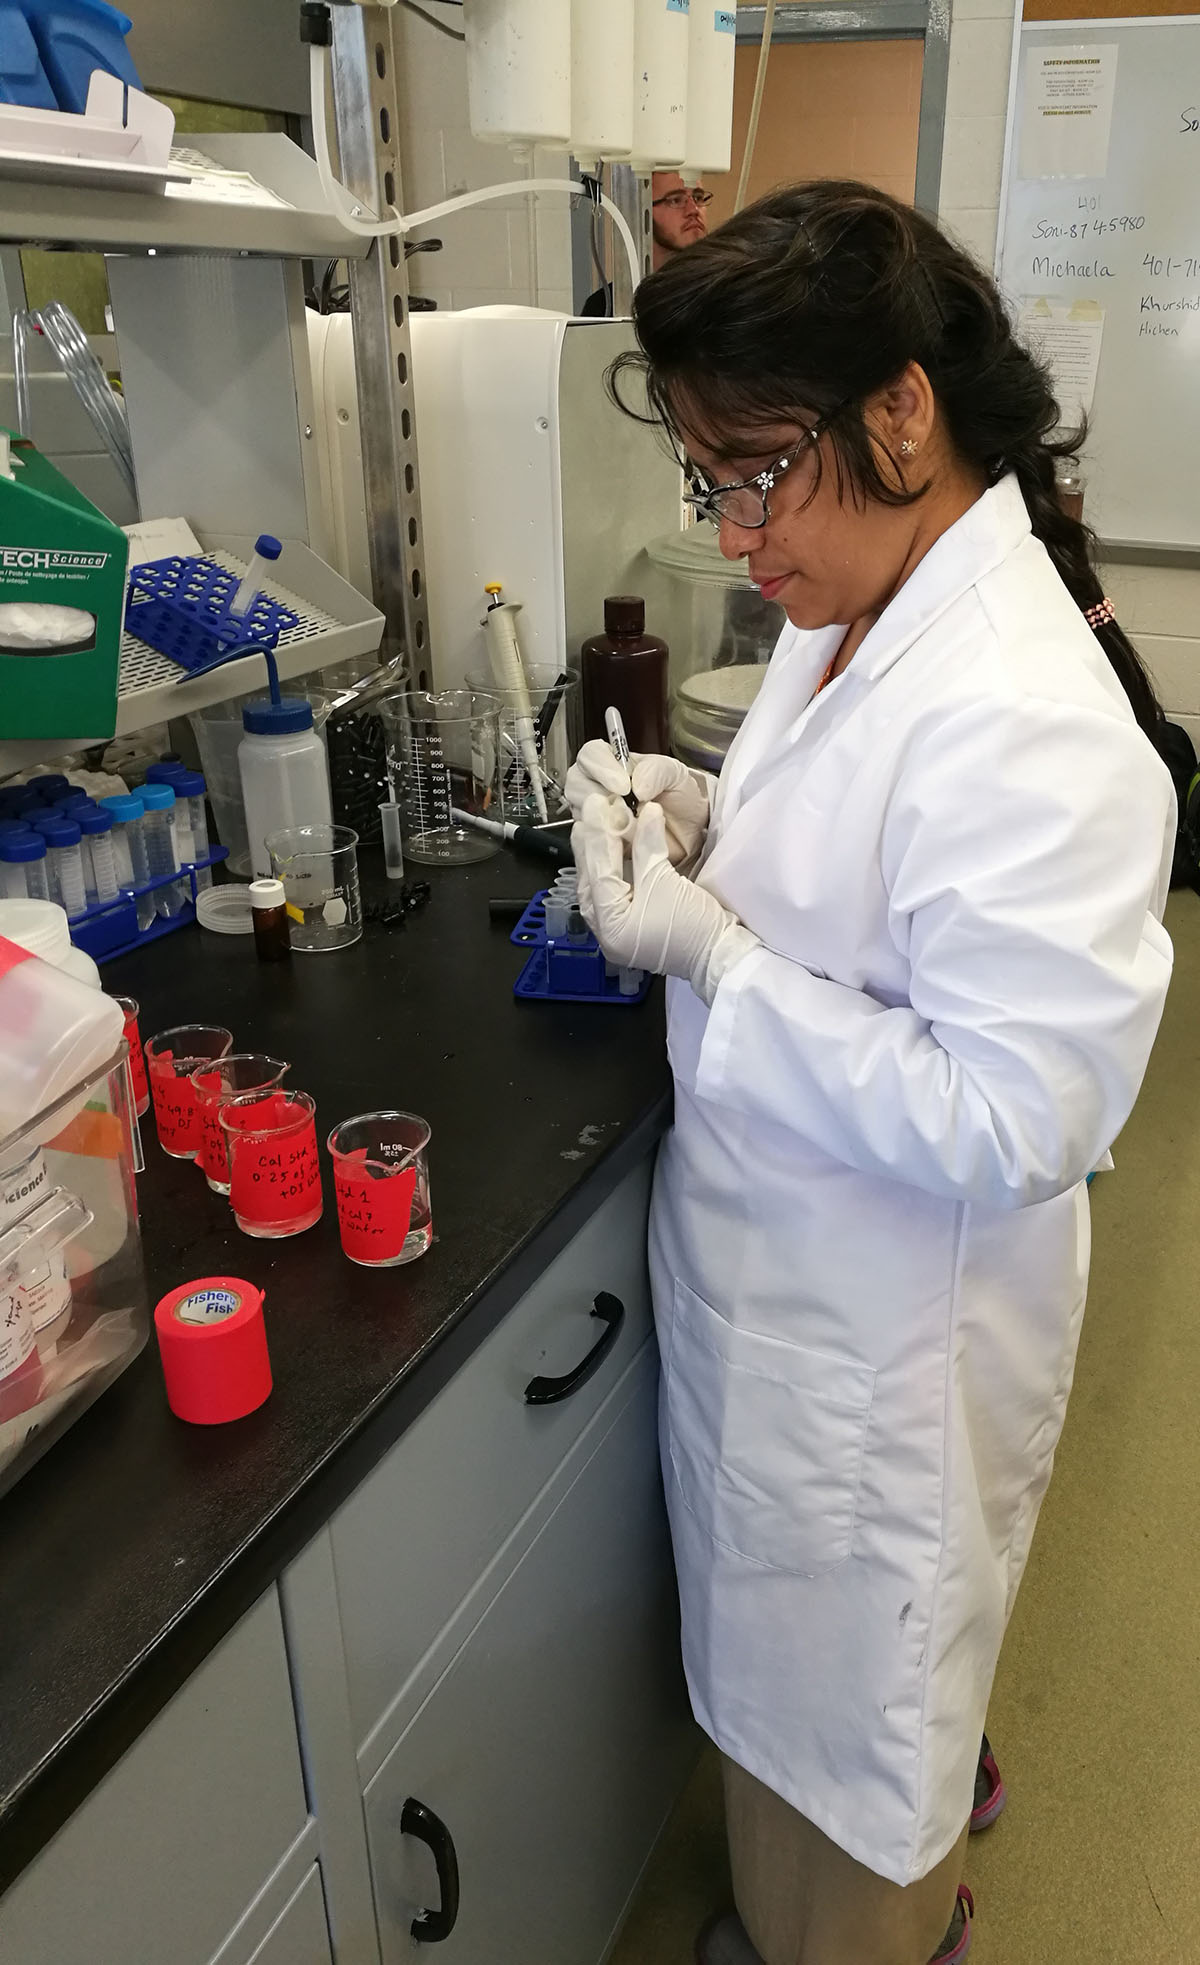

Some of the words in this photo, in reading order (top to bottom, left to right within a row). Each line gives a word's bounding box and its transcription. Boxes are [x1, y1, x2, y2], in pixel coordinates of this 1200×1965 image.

[1179, 106, 1200, 133] So
[1032, 257, 1117, 278] Michaela
[1143, 253, 1200, 278] 401-71
[52, 553, 102, 565] Science
[258, 1154, 281, 1168] Cal
